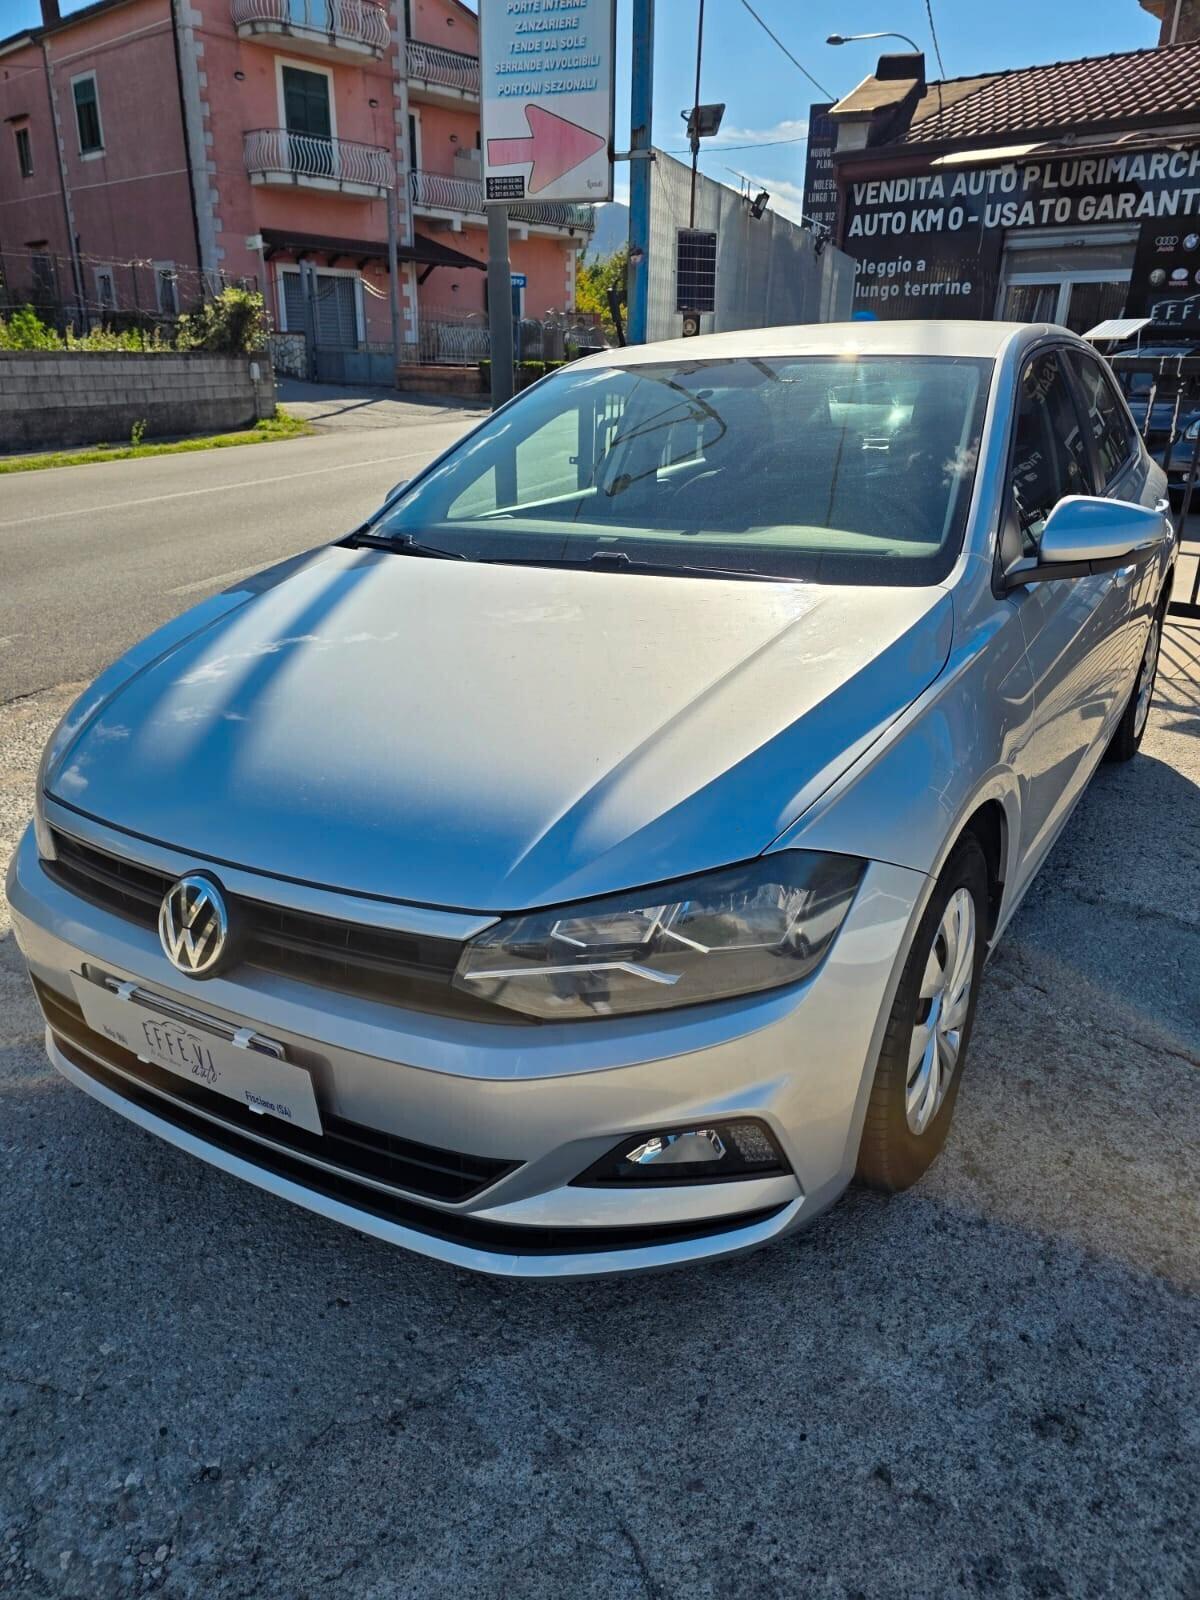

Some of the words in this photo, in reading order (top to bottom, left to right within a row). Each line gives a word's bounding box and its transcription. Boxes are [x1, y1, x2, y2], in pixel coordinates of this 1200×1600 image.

[507, 0, 540, 14] PORTE
[543, 0, 587, 11] INTERNE
[515, 17, 579, 34] ZANZARIERE
[510, 39, 541, 54] TENDE
[544, 39, 557, 52] DA
[560, 35, 586, 49] SOLE
[495, 60, 542, 75] SERRANDE
[544, 55, 600, 71] AVVOLGIBILI
[497, 81, 542, 96] PORTONI
[544, 78, 598, 94] SEZIONALI
[853, 175, 944, 206] VENDITA
[951, 167, 1017, 198] AUTO
[848, 210, 906, 237] AUTO
[910, 207, 944, 233] KM
[984, 197, 1072, 228] USATO
[1077, 187, 1200, 222] GARANT
[916, 259, 926, 272] a
[855, 282, 900, 301] lungo
[1150, 304, 1200, 320] EFF
